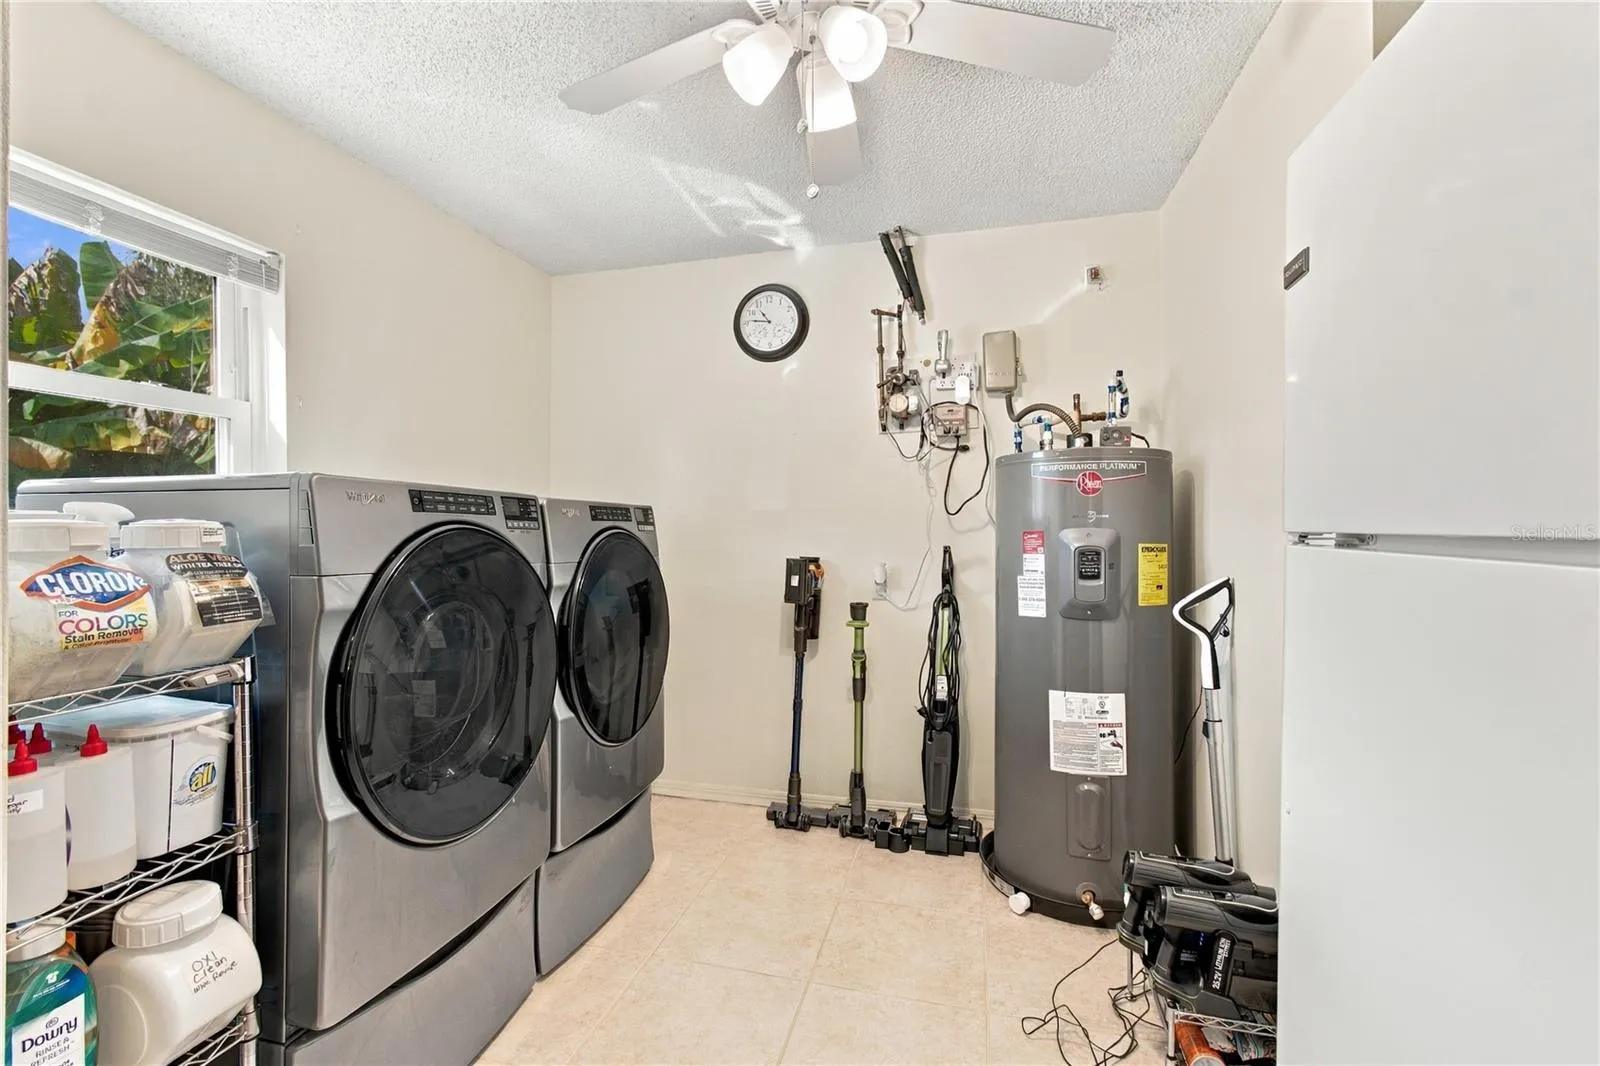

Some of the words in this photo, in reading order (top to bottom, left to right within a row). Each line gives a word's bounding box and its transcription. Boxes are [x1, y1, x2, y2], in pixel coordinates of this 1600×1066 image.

[1039, 462, 1098, 472] PERFORMANCE
[168, 553, 206, 564] ALOE
[208, 553, 241, 563] VERA
[171, 562, 196, 570] WITH
[35, 571, 143, 597] CLOROX
[58, 610, 79, 618] FOR
[58, 613, 149, 635] COLORS
[64, 633, 95, 645] Stain
[97, 627, 143, 641] Remover
[190, 763, 213, 791] all
[21, 1016, 78, 1054] Downy
[30, 1044, 70, 1066] REFRESH
[35, 1040, 63, 1058] RINSE
